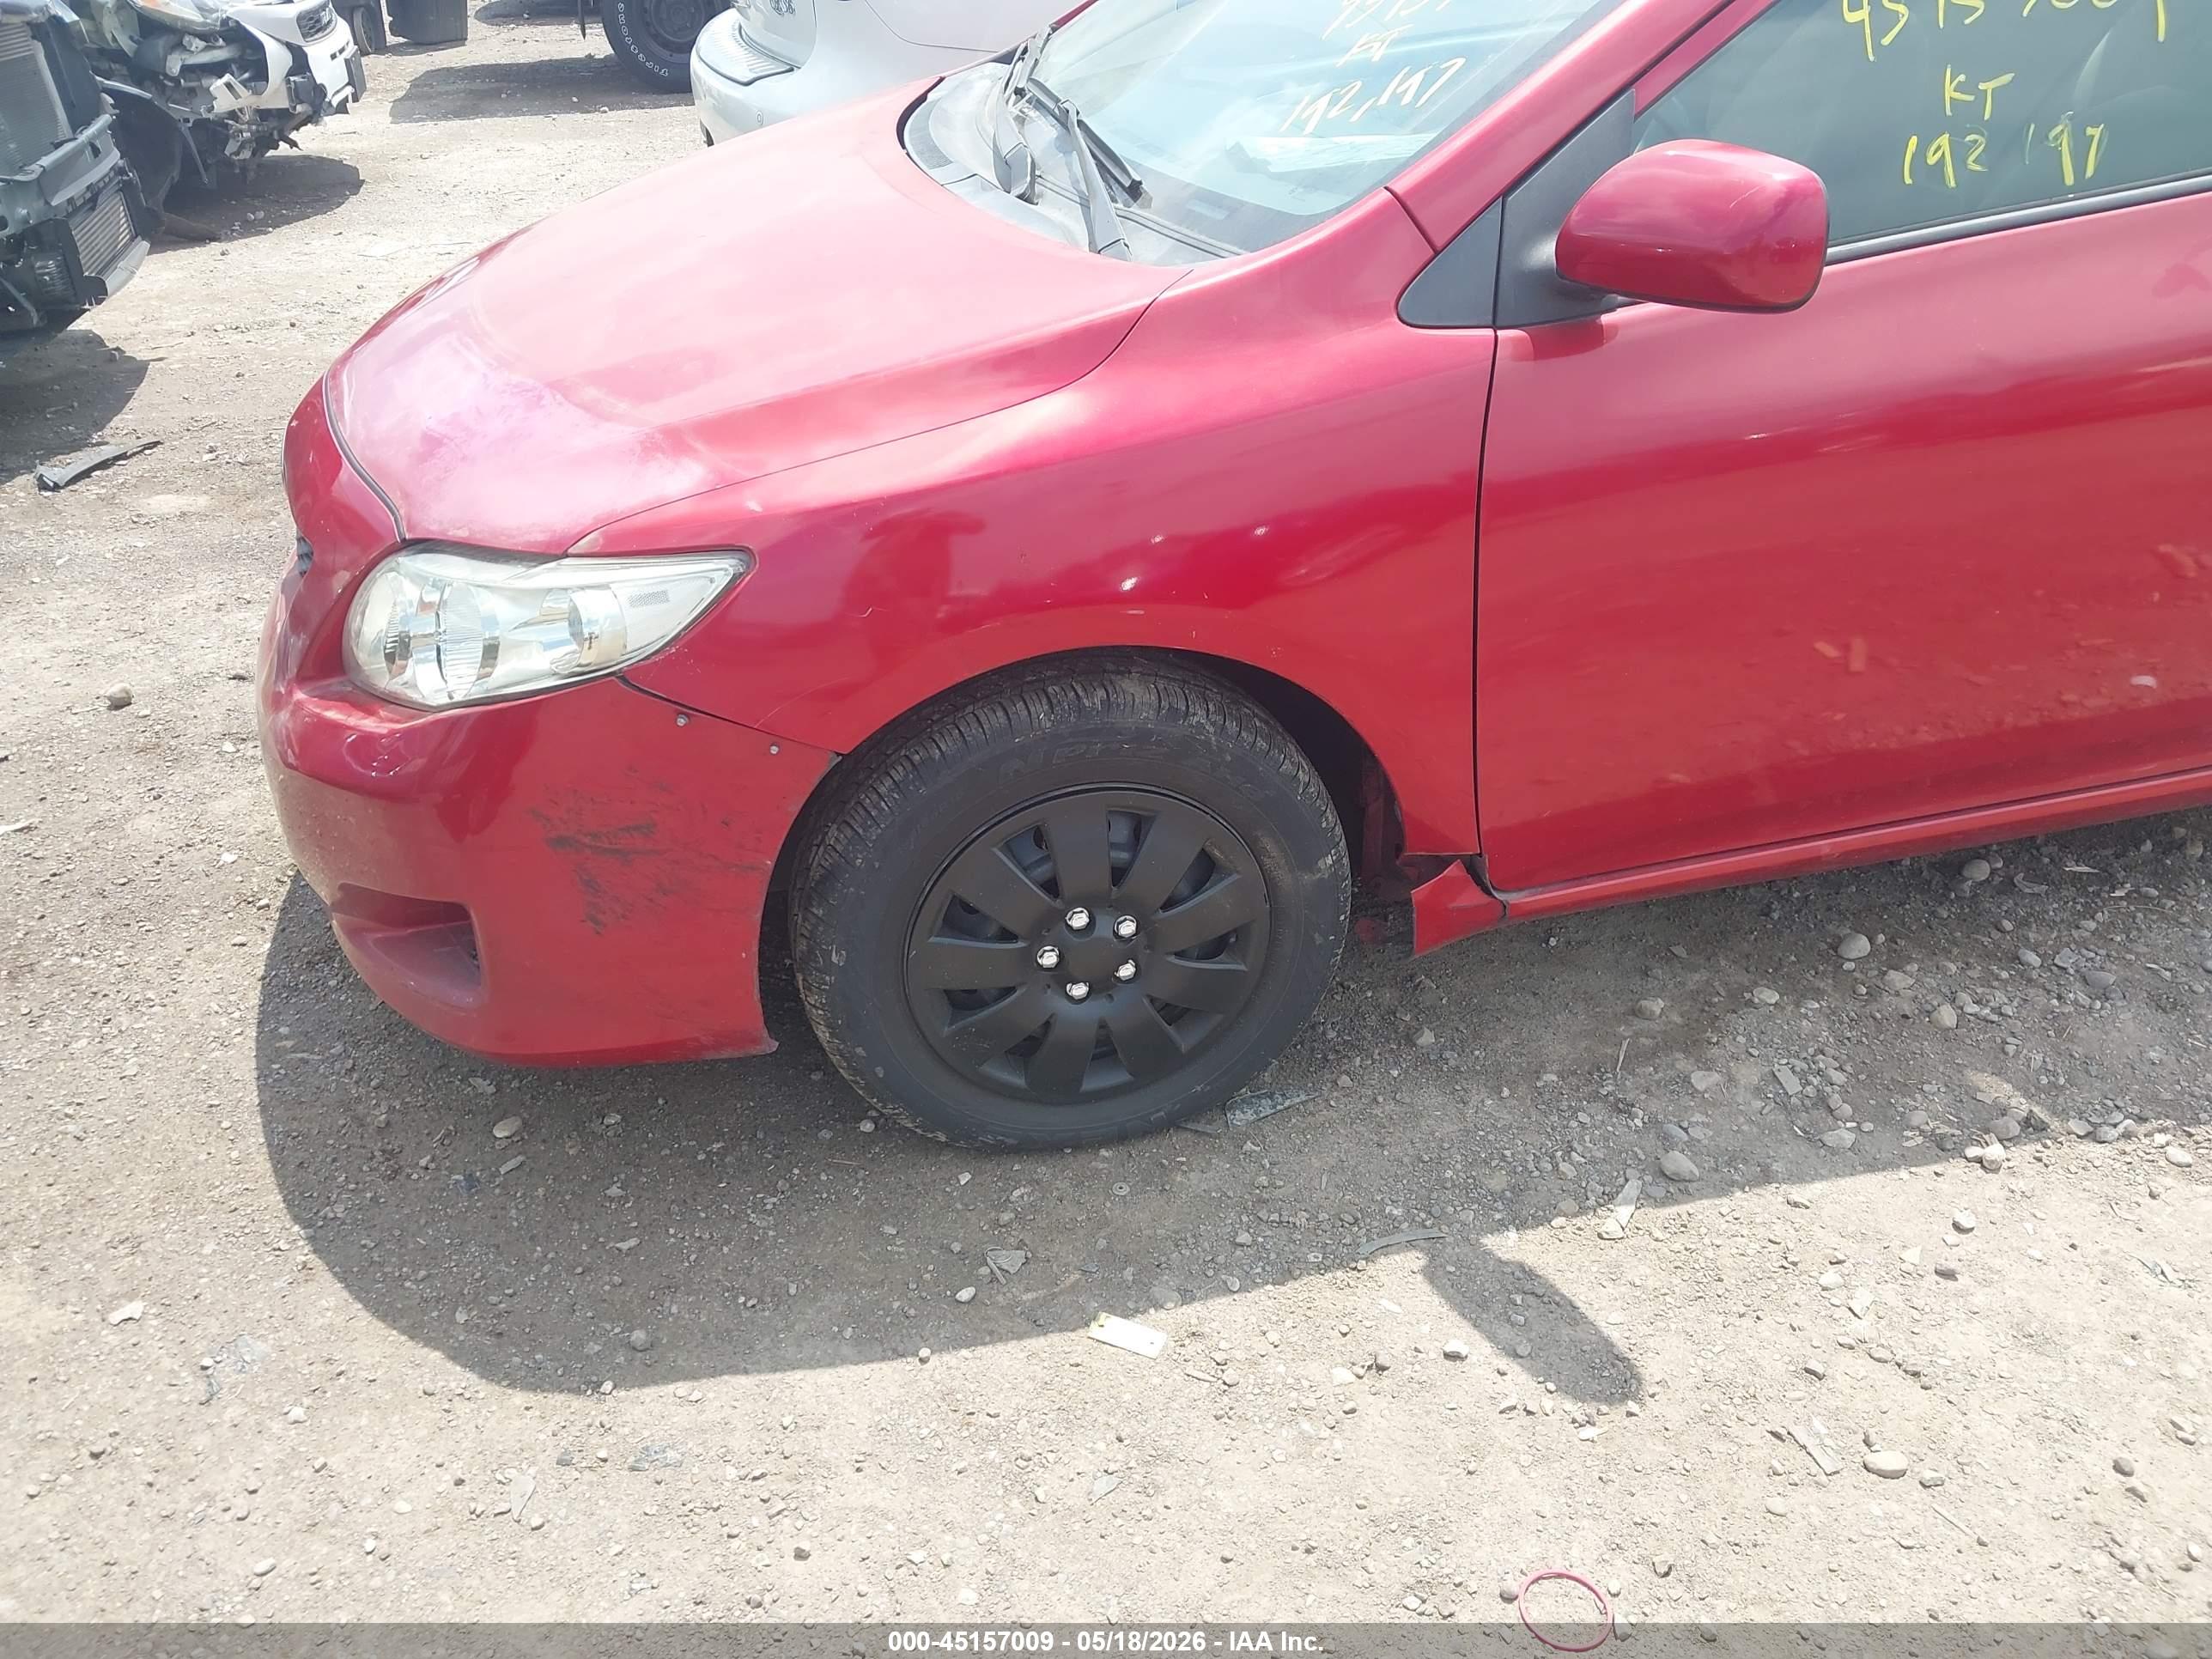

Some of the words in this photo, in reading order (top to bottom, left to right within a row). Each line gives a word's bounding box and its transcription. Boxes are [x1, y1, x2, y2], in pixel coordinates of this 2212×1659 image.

[1942, 64, 2015, 121] KT
[1903, 125, 1989, 189] 192
[2023, 112, 2109, 186] 197
